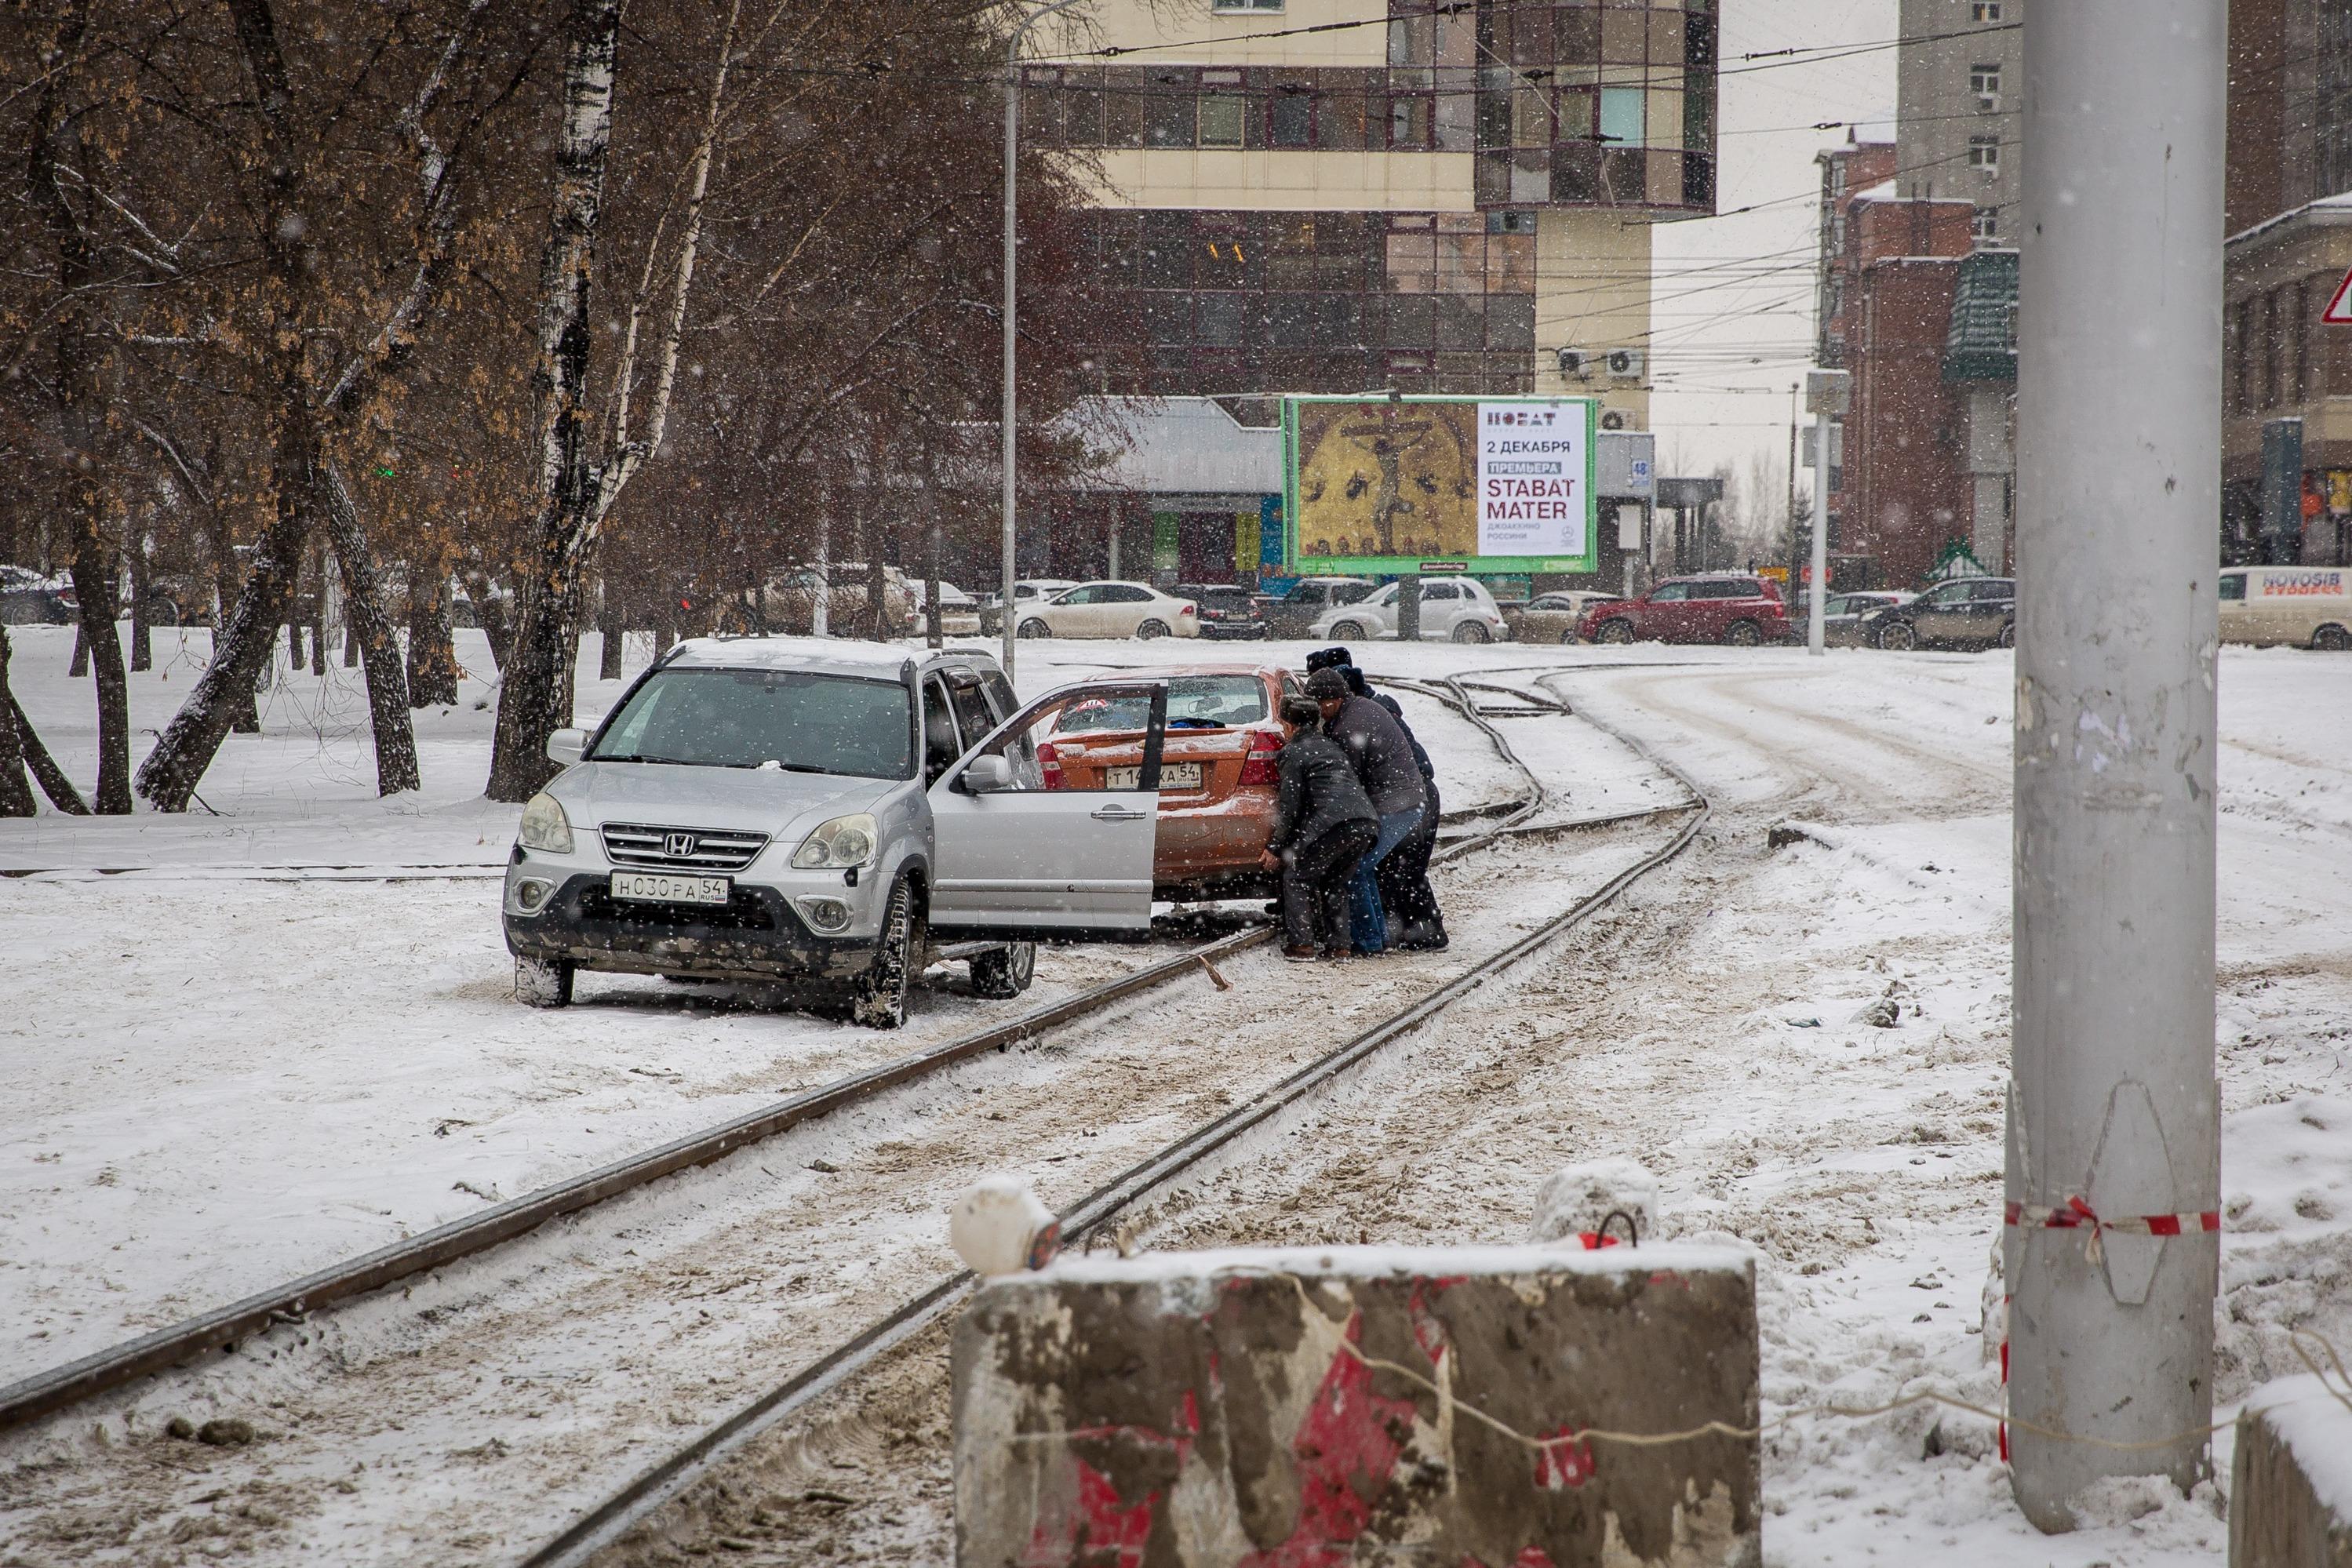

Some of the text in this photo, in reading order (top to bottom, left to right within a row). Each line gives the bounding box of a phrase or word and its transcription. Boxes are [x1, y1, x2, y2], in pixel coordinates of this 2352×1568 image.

[1487, 441, 1571, 454] 2 ДЕКАБРЯ
[1488, 462, 1560, 474] ПРЕМЬЕРА
[1634, 462, 1646, 475] 48
[1487, 478, 1575, 497] STABAT
[1487, 501, 1567, 519] MATER
[2263, 572, 2341, 587] NOVOSIB
[1179, 765, 1196, 777] 54
[702, 879, 721, 895] 54
